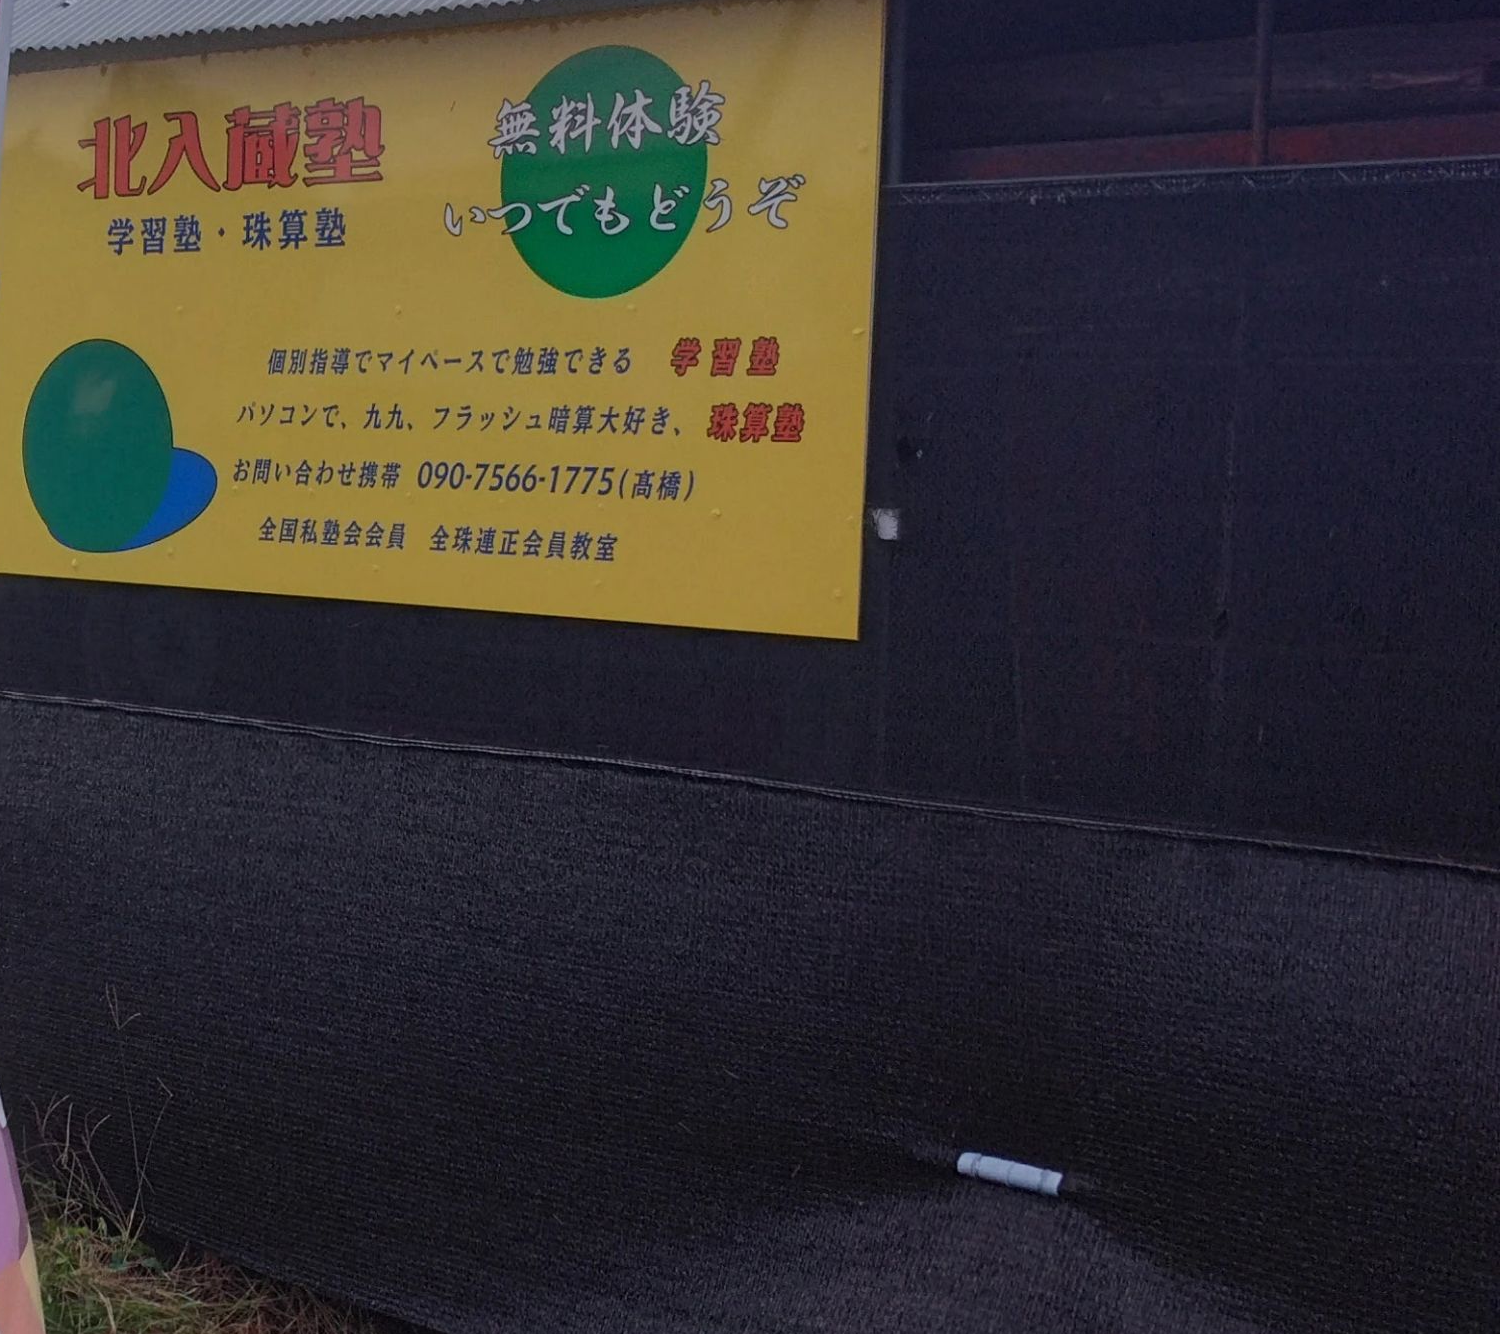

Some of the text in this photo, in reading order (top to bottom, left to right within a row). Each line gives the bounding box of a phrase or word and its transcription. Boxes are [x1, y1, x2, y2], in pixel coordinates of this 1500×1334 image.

[488, 79, 725, 159] 無料体験
[77, 96, 385, 199] 北入蔵塾
[444, 174, 805, 237] いつでもどうぞ
[107, 207, 347, 256] 学習塾・珠算塾
[267, 336, 780, 377] 個別指導でマイペースで勉強できる 学習塾
[706, 402, 805, 442] 珠算塾
[232, 458, 401, 490] お問い合わせ携帯
[257, 516, 619, 562] 全国私塾会会員 全珠連正会員教室
